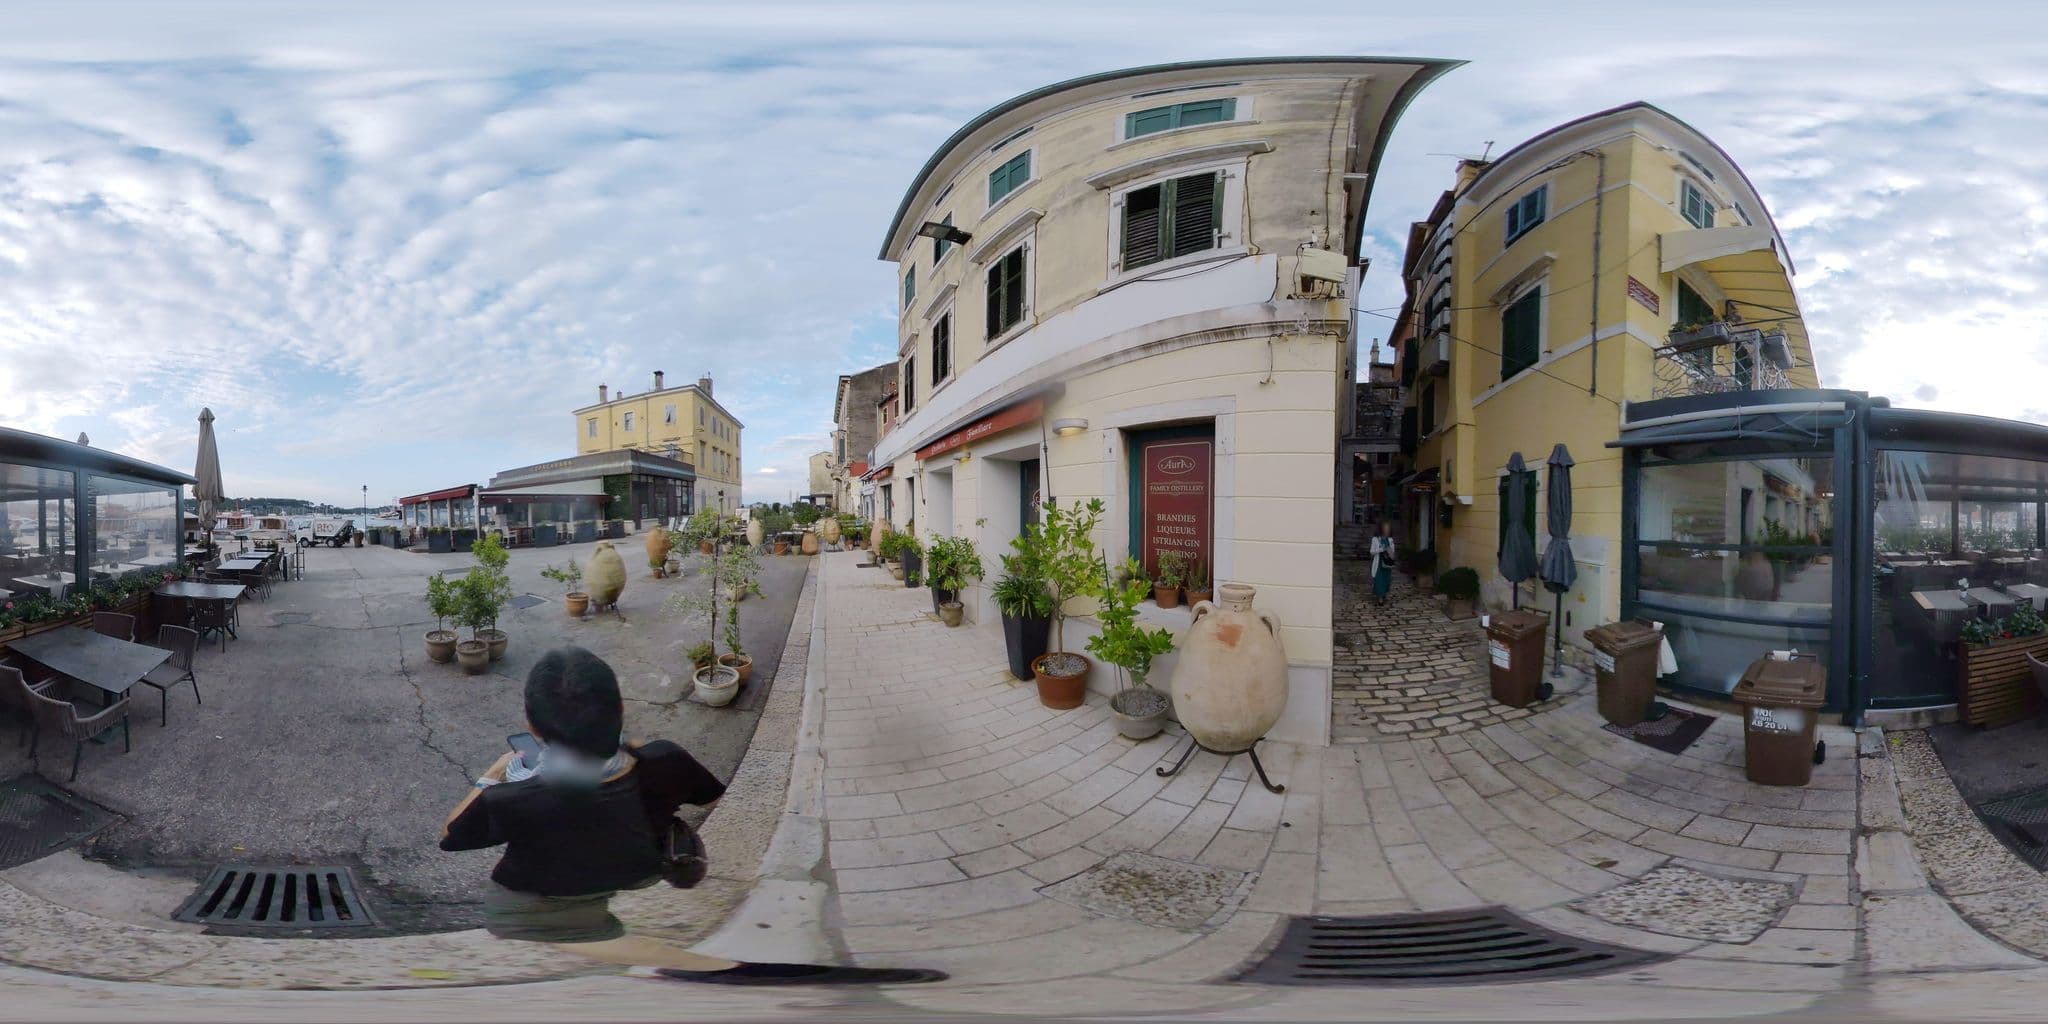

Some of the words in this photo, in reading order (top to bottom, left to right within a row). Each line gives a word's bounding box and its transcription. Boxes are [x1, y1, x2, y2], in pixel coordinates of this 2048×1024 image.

[1157, 513, 1196, 523] BRANDIES
[1157, 525, 1196, 535] LIQUEURS
[1152, 536, 1182, 546] ISTRIAN
[1184, 539, 1200, 547] GIN
[1764, 721, 1776, 729] 20
